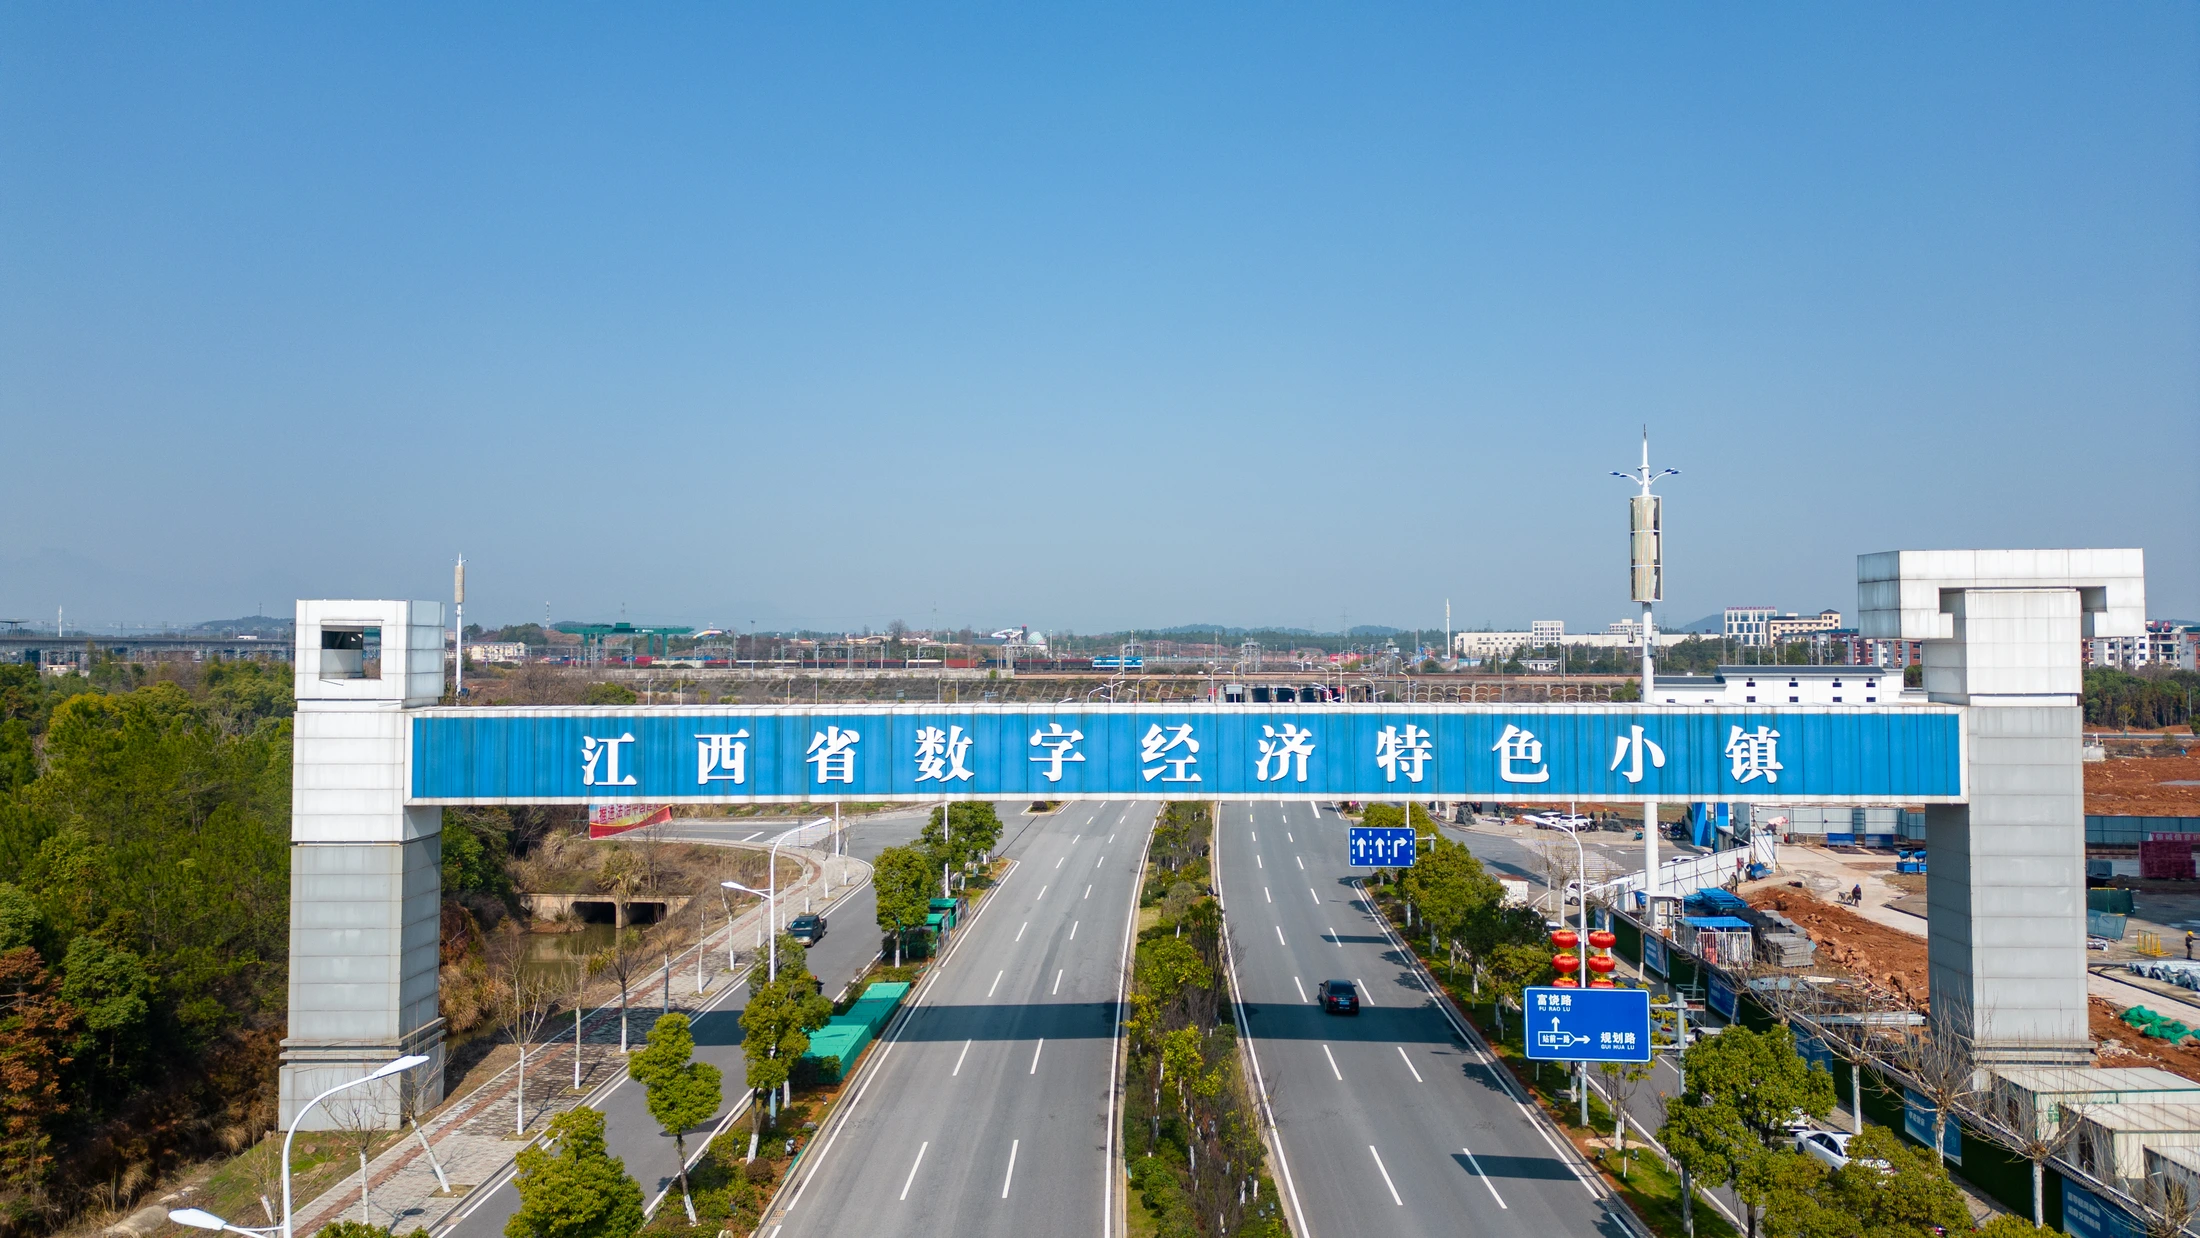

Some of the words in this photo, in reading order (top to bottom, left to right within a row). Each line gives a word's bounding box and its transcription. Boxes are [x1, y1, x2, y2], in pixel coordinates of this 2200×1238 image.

[581, 723, 1784, 786] 江西省数字经济特色小镇
[1537, 994, 1572, 1006] 富饶路
[1542, 1034, 1570, 1044] 站前一路
[1600, 1032, 1636, 1044] 规划路
